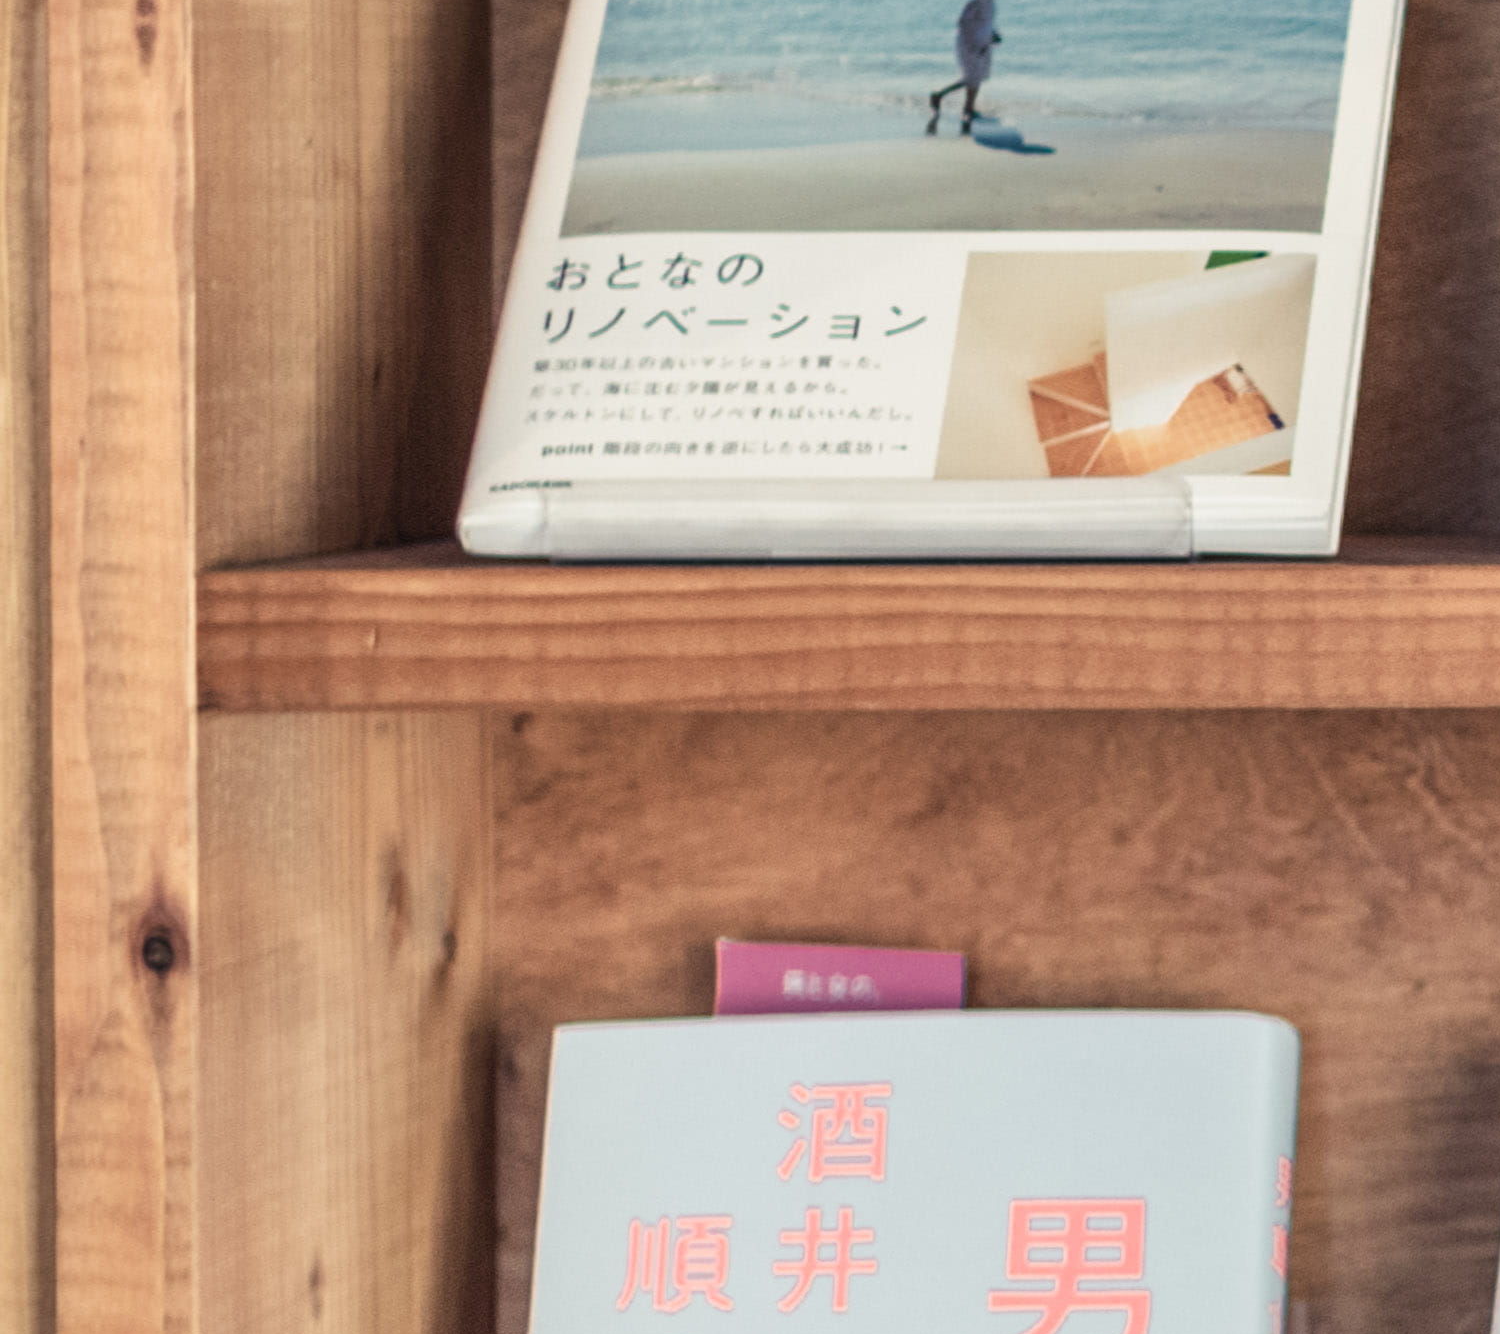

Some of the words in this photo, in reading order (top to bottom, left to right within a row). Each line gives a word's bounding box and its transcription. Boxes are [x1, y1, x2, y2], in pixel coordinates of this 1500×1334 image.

[545, 251, 765, 291] おとなの
[543, 302, 928, 344] リノベーション
[540, 441, 595, 458] point
[772, 1080, 893, 1313] 酒井
